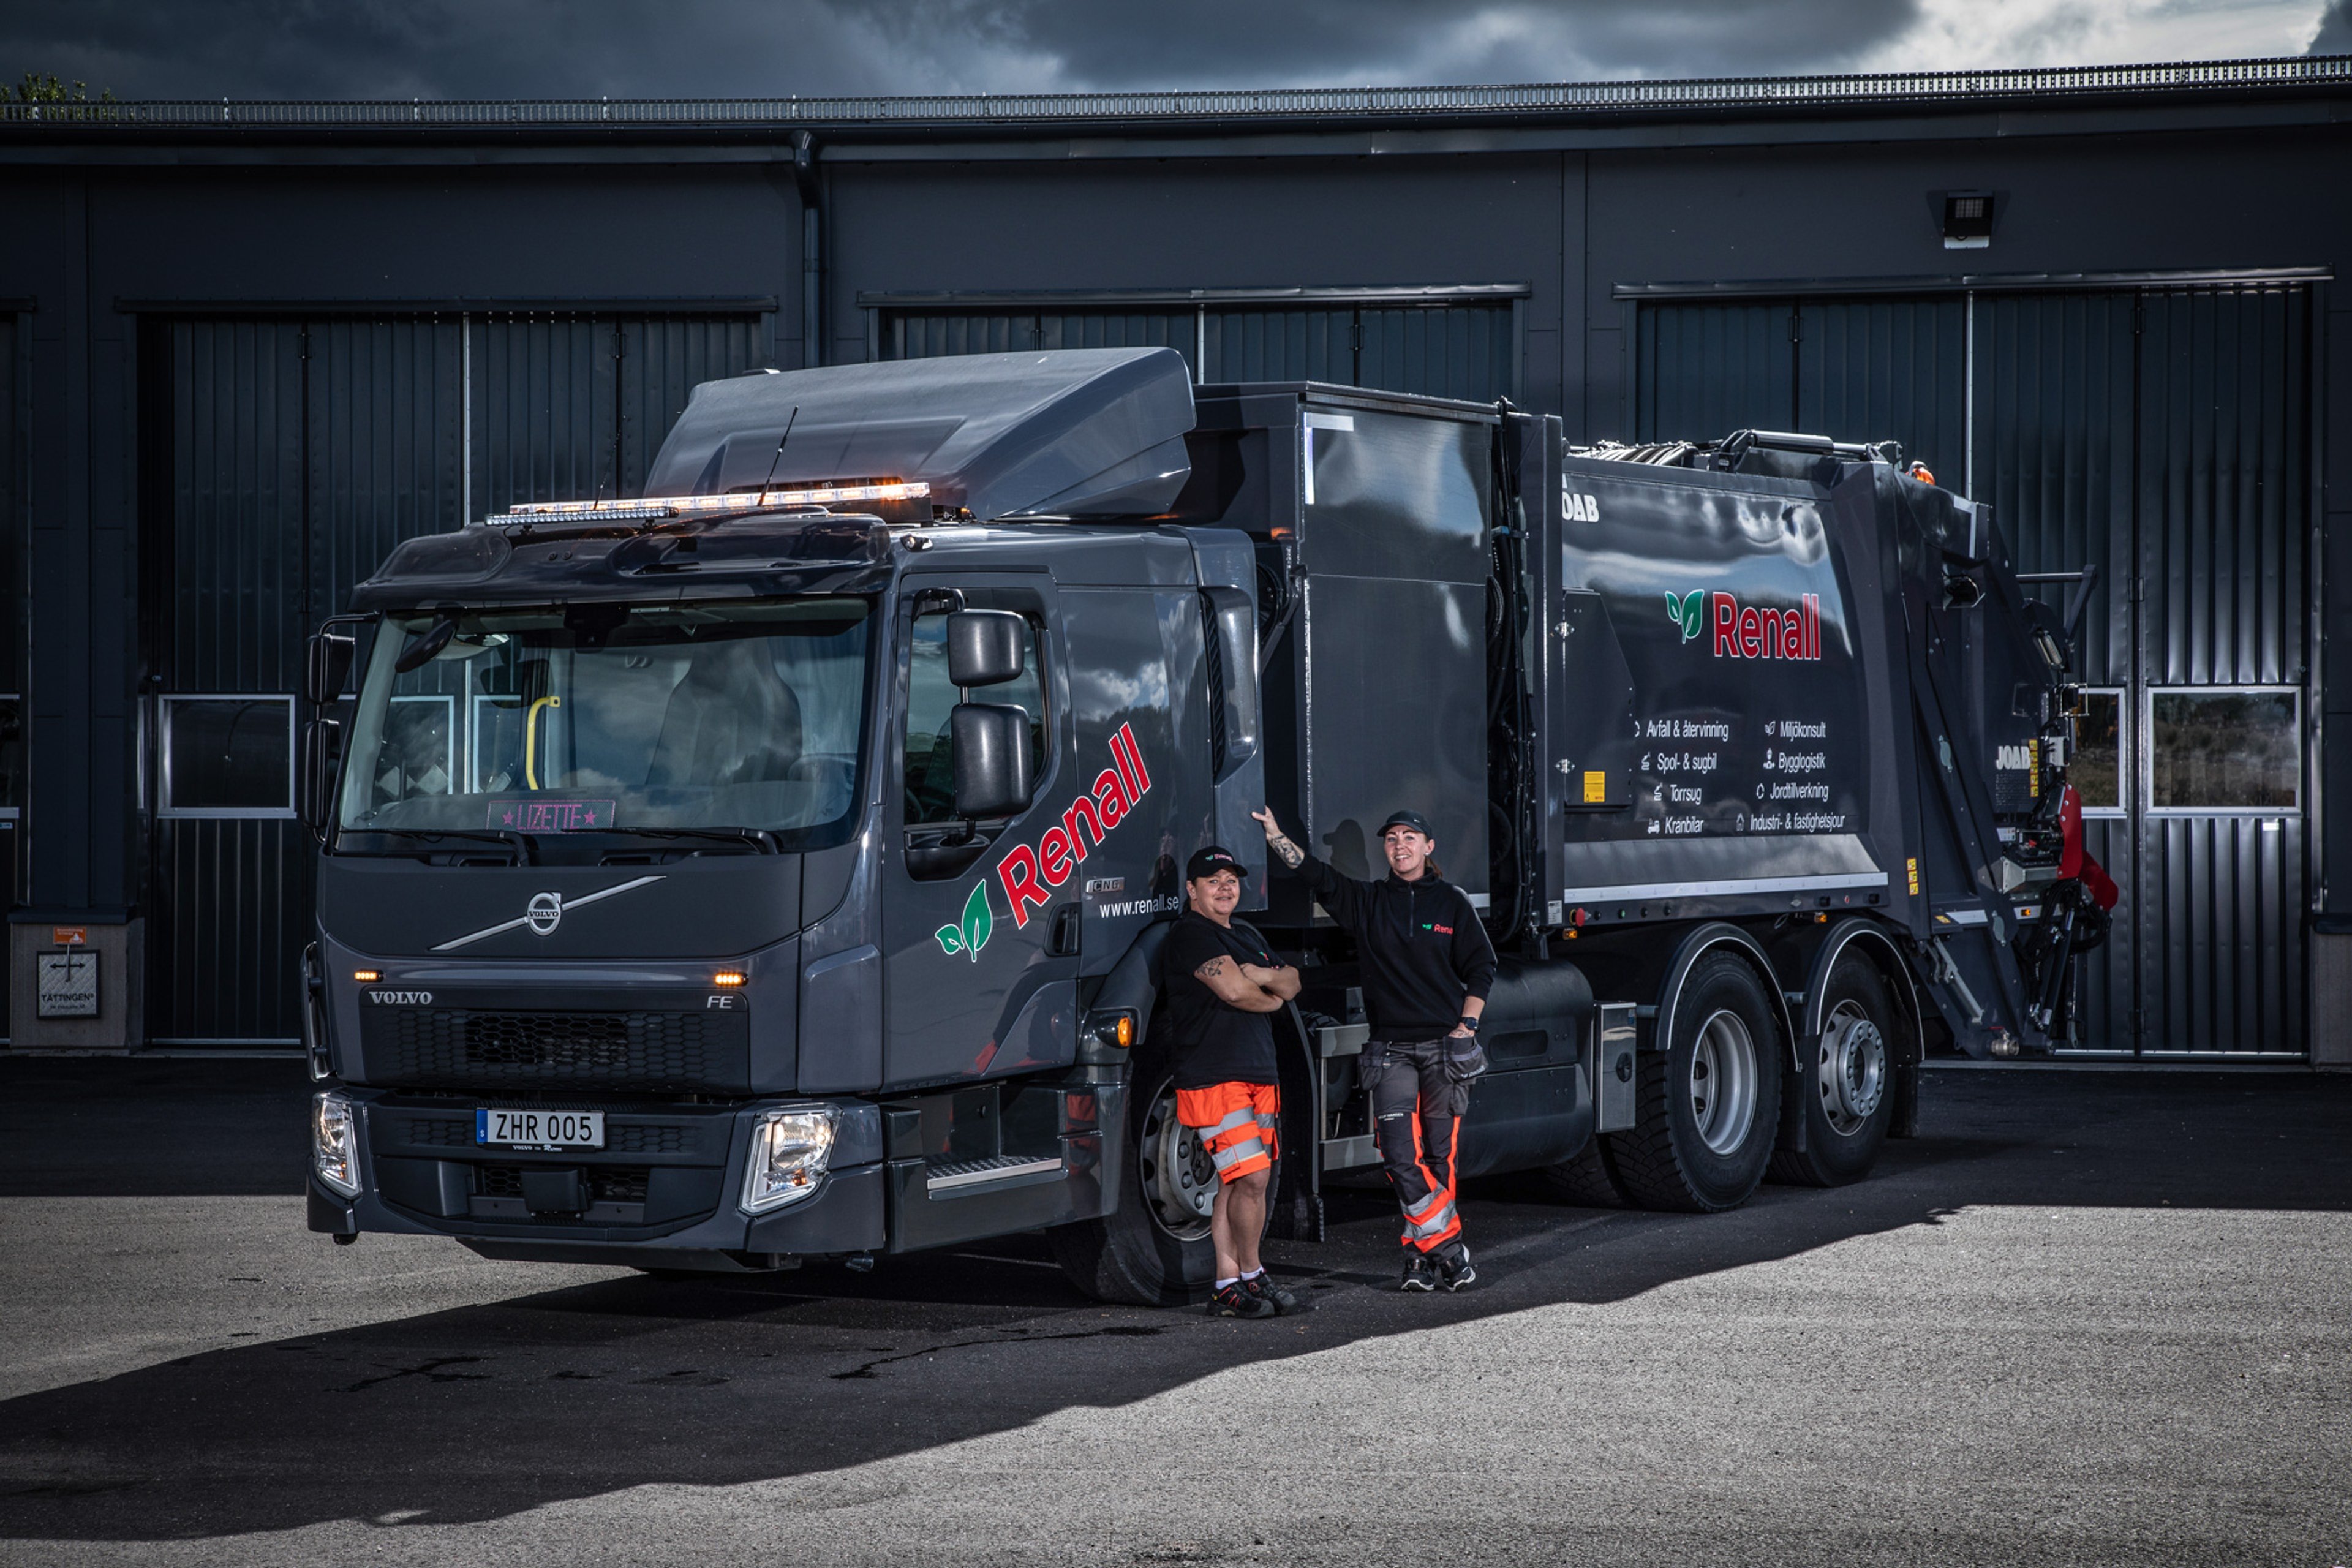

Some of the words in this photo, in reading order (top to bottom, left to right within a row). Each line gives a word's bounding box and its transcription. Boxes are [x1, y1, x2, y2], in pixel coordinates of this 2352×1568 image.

[1562, 491, 1599, 522] OAB
[1713, 591, 1821, 660] Renall
[1646, 720, 1671, 737] Avfall
[1673, 720, 1680, 737] &
[1683, 720, 1729, 742] återvinning
[1780, 720, 1826, 742] Miljökonsult
[1657, 752, 1681, 775] Spol-
[1683, 752, 1690, 770] &
[1692, 752, 1717, 774] sugbil
[1778, 752, 1826, 774] Bygglogistik
[1996, 744, 2030, 770] JOAB
[1670, 784, 1702, 806] Torrsug
[1770, 782, 1829, 802] Jordtillverkning
[516, 804, 582, 830] LIZETTE
[997, 721, 1152, 930] Renall
[1664, 816, 1704, 834] Kranbilar
[1750, 813, 1783, 831] Industri-
[1785, 812, 1792, 829] &
[1793, 812, 1845, 833] fastighetsjour
[1093, 880, 1119, 892] CNG
[1099, 893, 1179, 918] www.renall.se
[368, 991, 432, 1005] VOLVO
[706, 995, 734, 1009] FE
[496, 1114, 538, 1140] ZHR
[548, 1115, 592, 1142] 005
